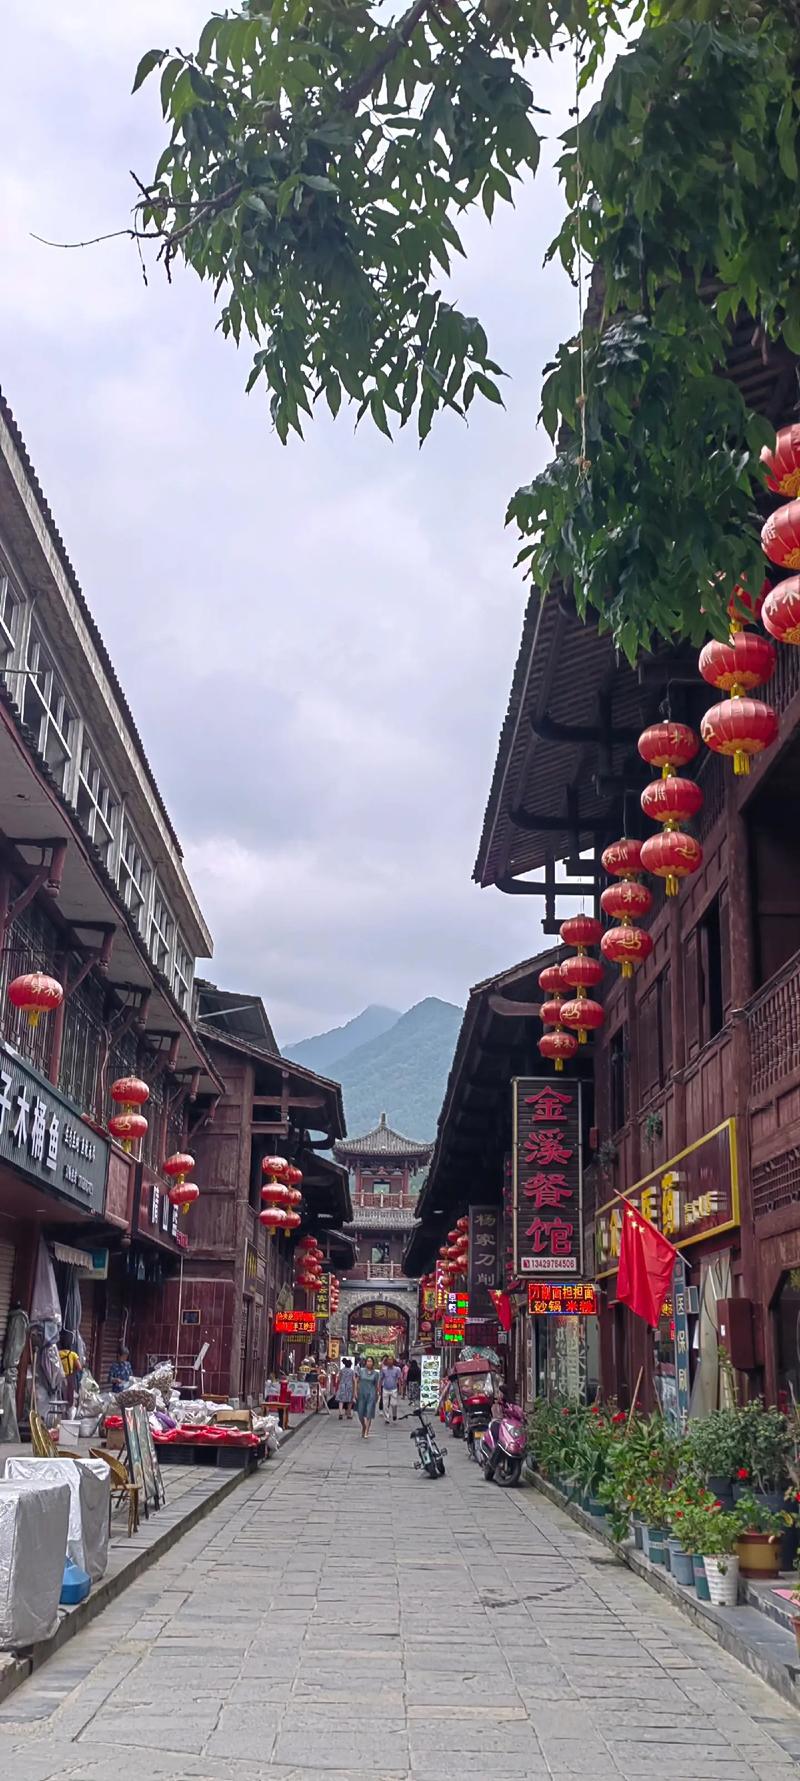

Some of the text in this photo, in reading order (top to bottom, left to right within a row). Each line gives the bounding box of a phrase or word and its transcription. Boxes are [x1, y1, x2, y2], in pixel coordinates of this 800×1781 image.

[524, 1086, 573, 1255] 金溪餐馆
[530, 1285, 595, 1300] 刀削面担担面
[534, 1300, 562, 1313] 砂锅
